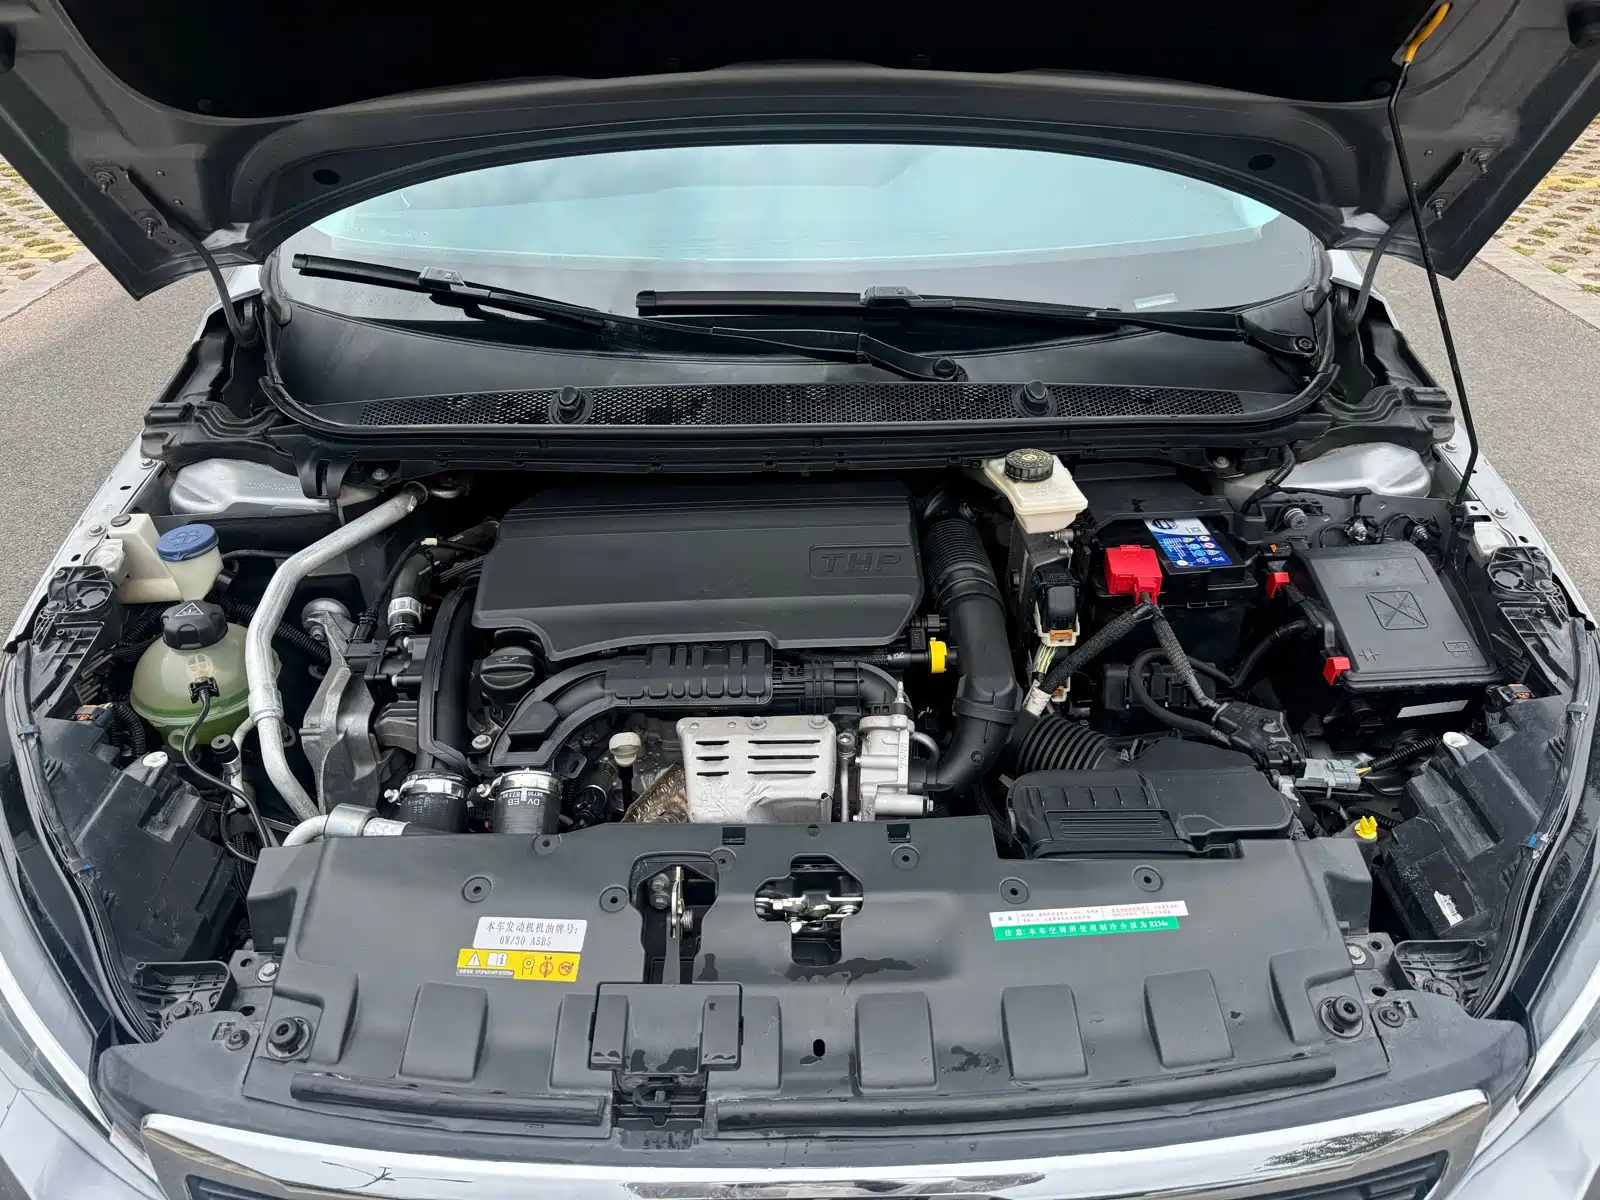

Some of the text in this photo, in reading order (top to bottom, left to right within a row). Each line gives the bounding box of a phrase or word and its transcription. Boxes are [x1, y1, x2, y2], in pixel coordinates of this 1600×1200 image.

[821, 551, 902, 572] THP
[499, 935, 552, 947] 0W/30 A5B5
